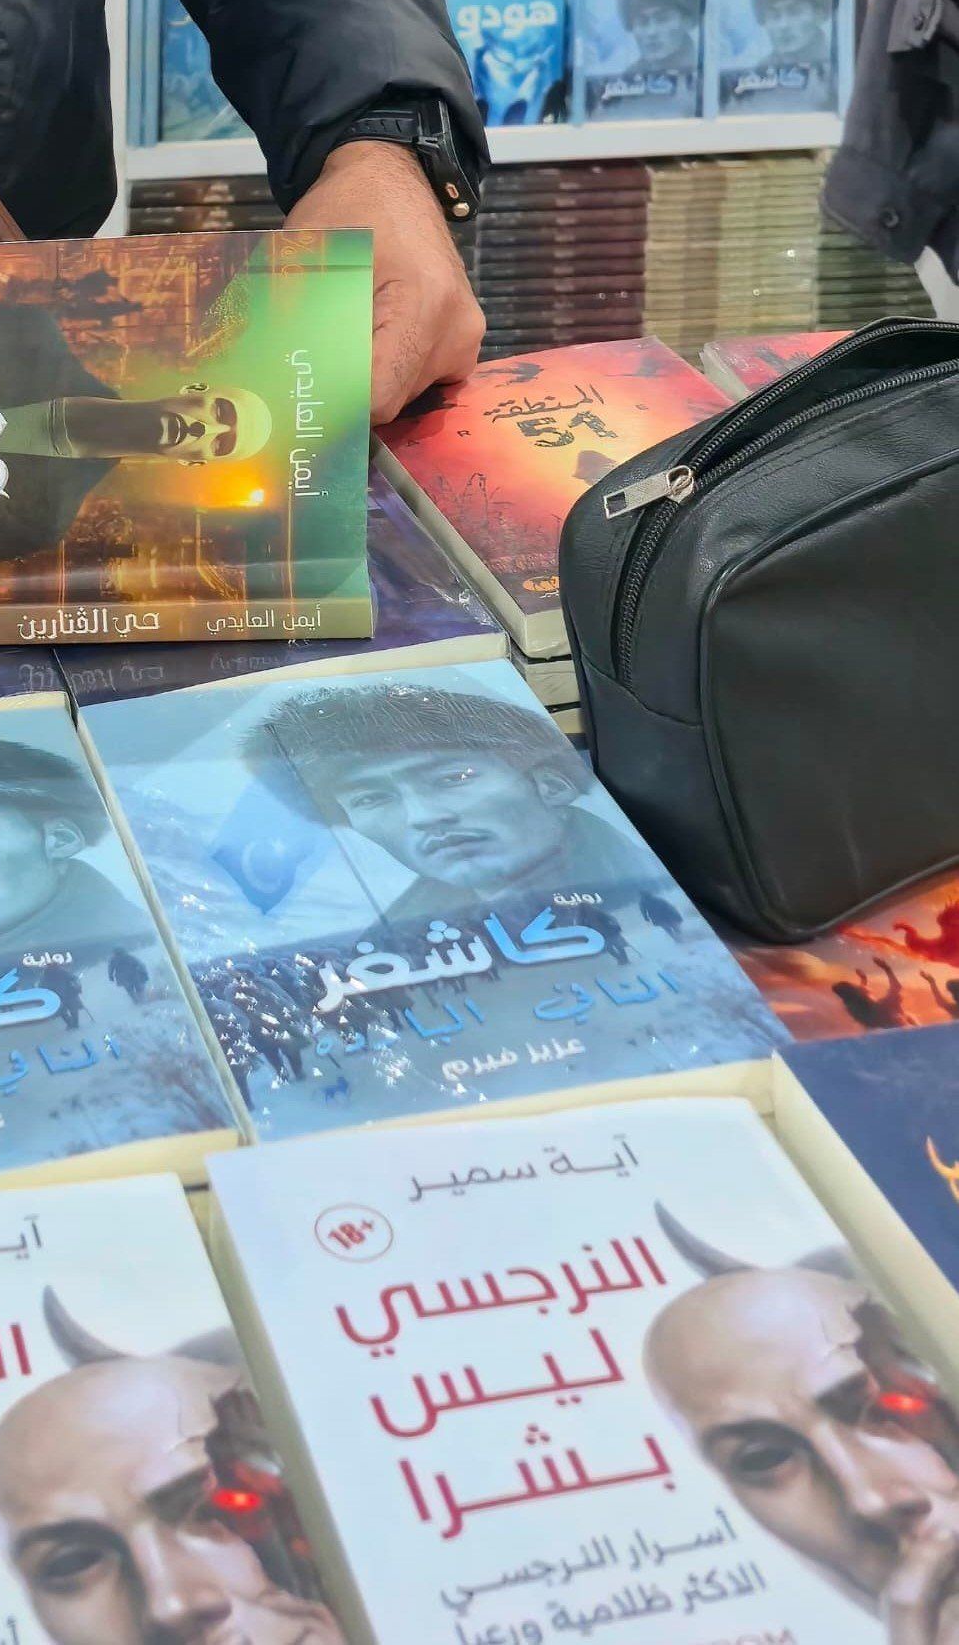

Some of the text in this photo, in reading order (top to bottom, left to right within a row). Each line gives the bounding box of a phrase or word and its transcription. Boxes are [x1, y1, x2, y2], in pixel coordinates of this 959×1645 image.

[456, 1, 558, 51] هودو
[284, 348, 329, 498] أيمن العايدي
[483, 382, 605, 424] المنطقة
[516, 410, 618, 448] 51
[112, 609, 160, 634] حي
[205, 609, 275, 635] العايدي
[282, 602, 323, 632] أيمن
[552, 890, 605, 907] رواية
[22, 949, 72, 967] رواية
[407, 1132, 640, 1202] آية سمير
[327, 1216, 378, 1251] 18+
[335, 1236, 670, 1358] النرجسي
[370, 1327, 627, 1440] ليس
[398, 1423, 677, 1541] بشرا
[440, 1505, 739, 1617] أسرار النرجسي
[547, 1583, 674, 1637] ظلامية
